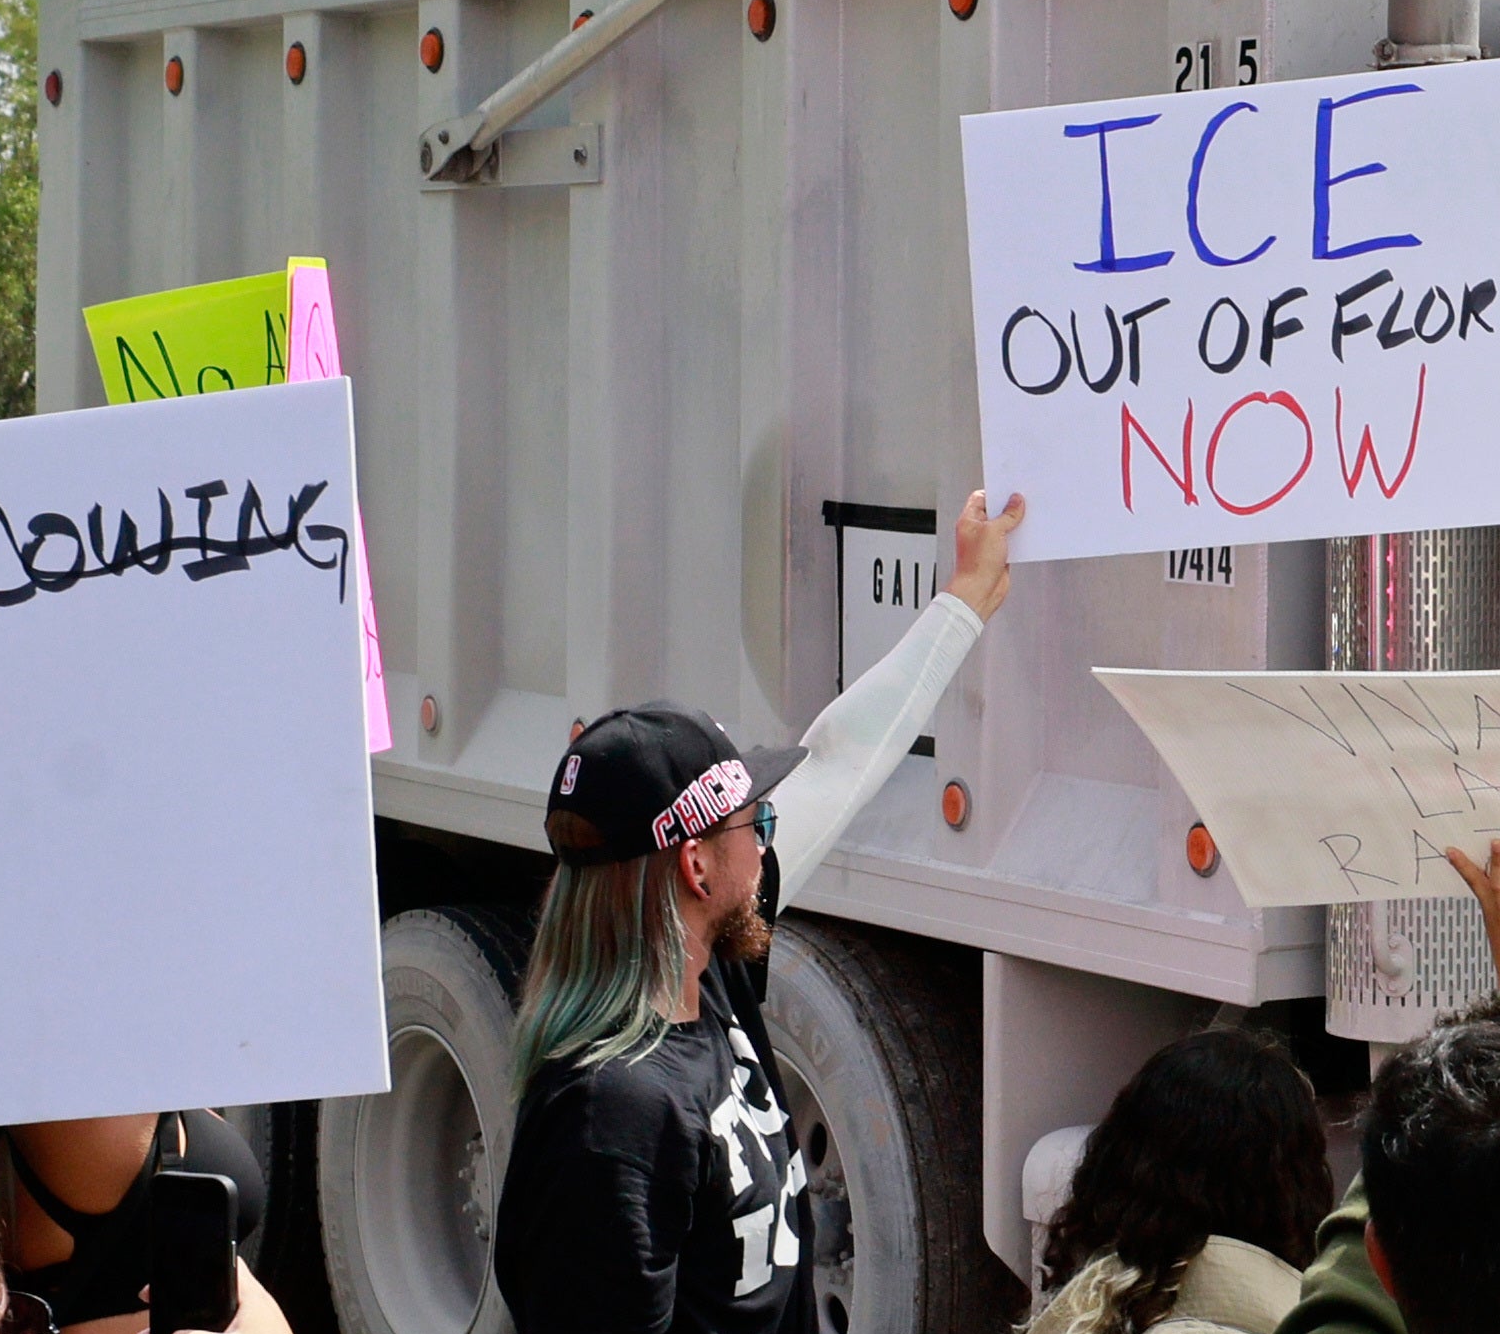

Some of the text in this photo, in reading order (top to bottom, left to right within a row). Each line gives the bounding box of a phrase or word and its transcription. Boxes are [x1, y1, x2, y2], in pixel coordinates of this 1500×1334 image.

[1063, 84, 1425, 273] ICE
[263, 310, 287, 386] A
[1002, 297, 1171, 396] OUT
[1198, 287, 1308, 376] OF
[1121, 364, 1427, 515] NOW
